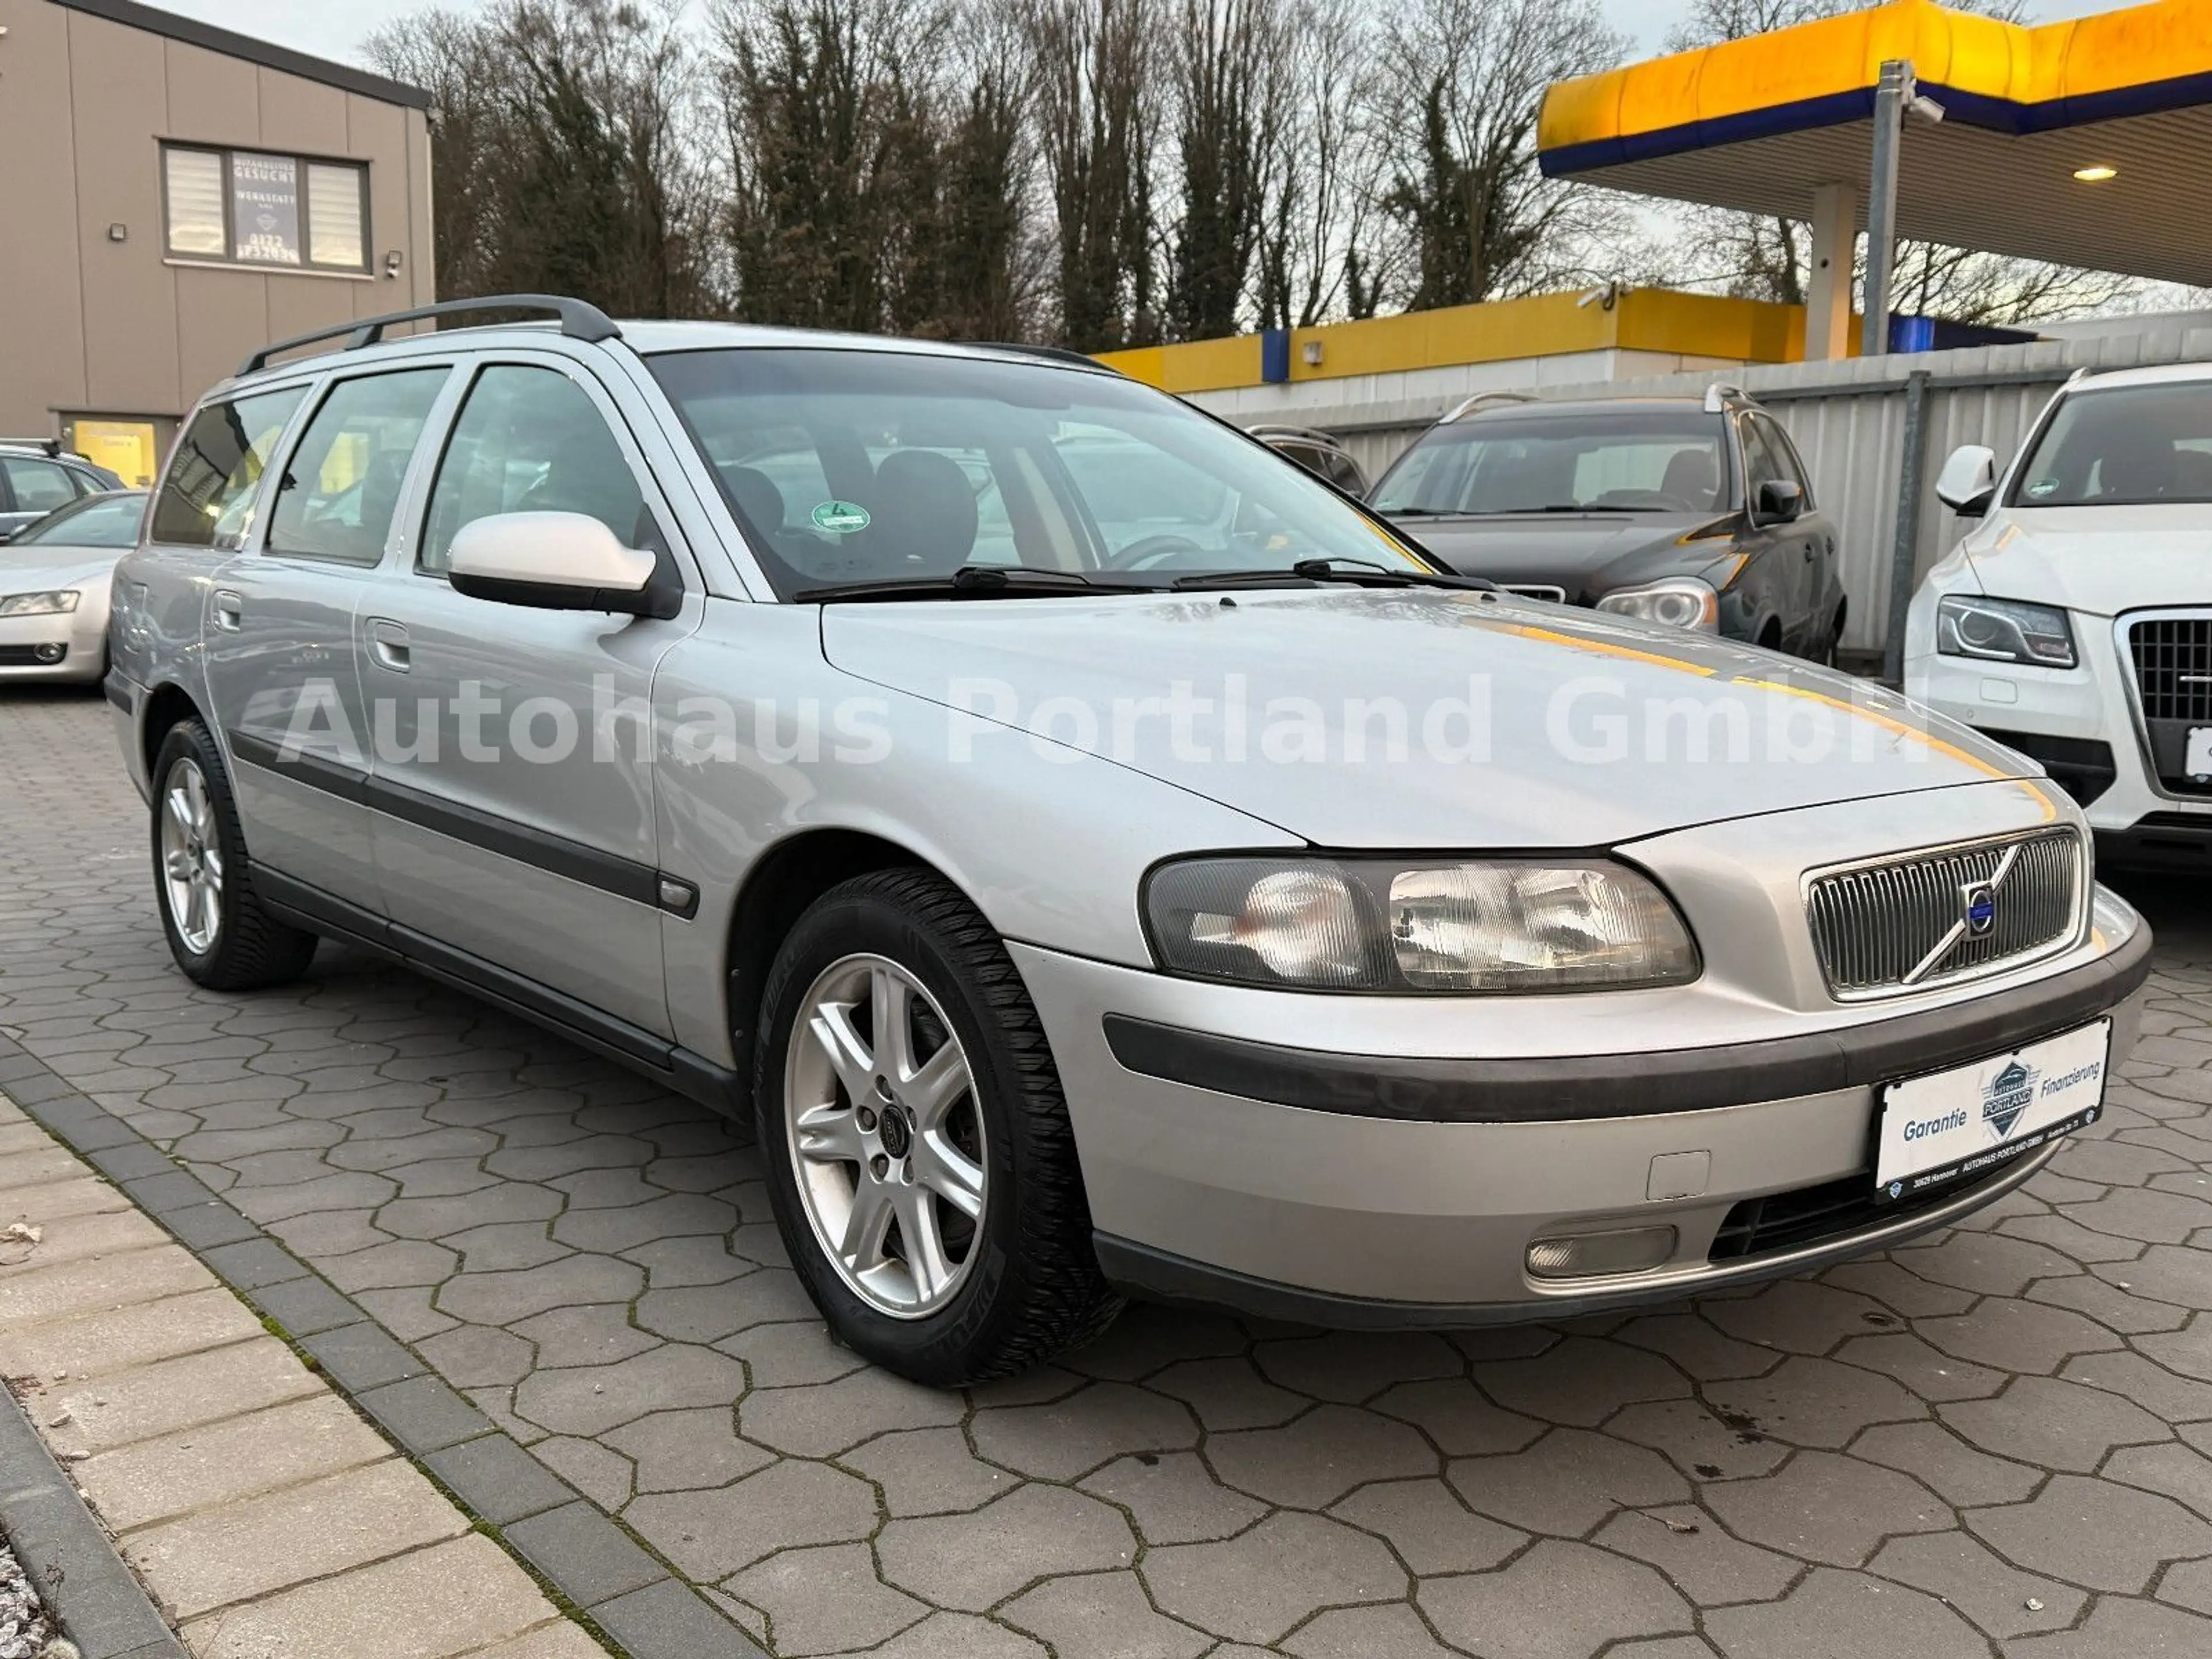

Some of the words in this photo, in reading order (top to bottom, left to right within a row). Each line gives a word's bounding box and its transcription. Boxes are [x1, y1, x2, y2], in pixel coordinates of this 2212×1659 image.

[1904, 1107, 1967, 1141] Garantie
[2040, 1062, 2100, 1099] Finanzierung
[1984, 1090, 2031, 1115] PORTLAND
[1963, 1153, 1996, 1173] AUTOHAUS
[1997, 1141, 2027, 1159] PORTLAND
